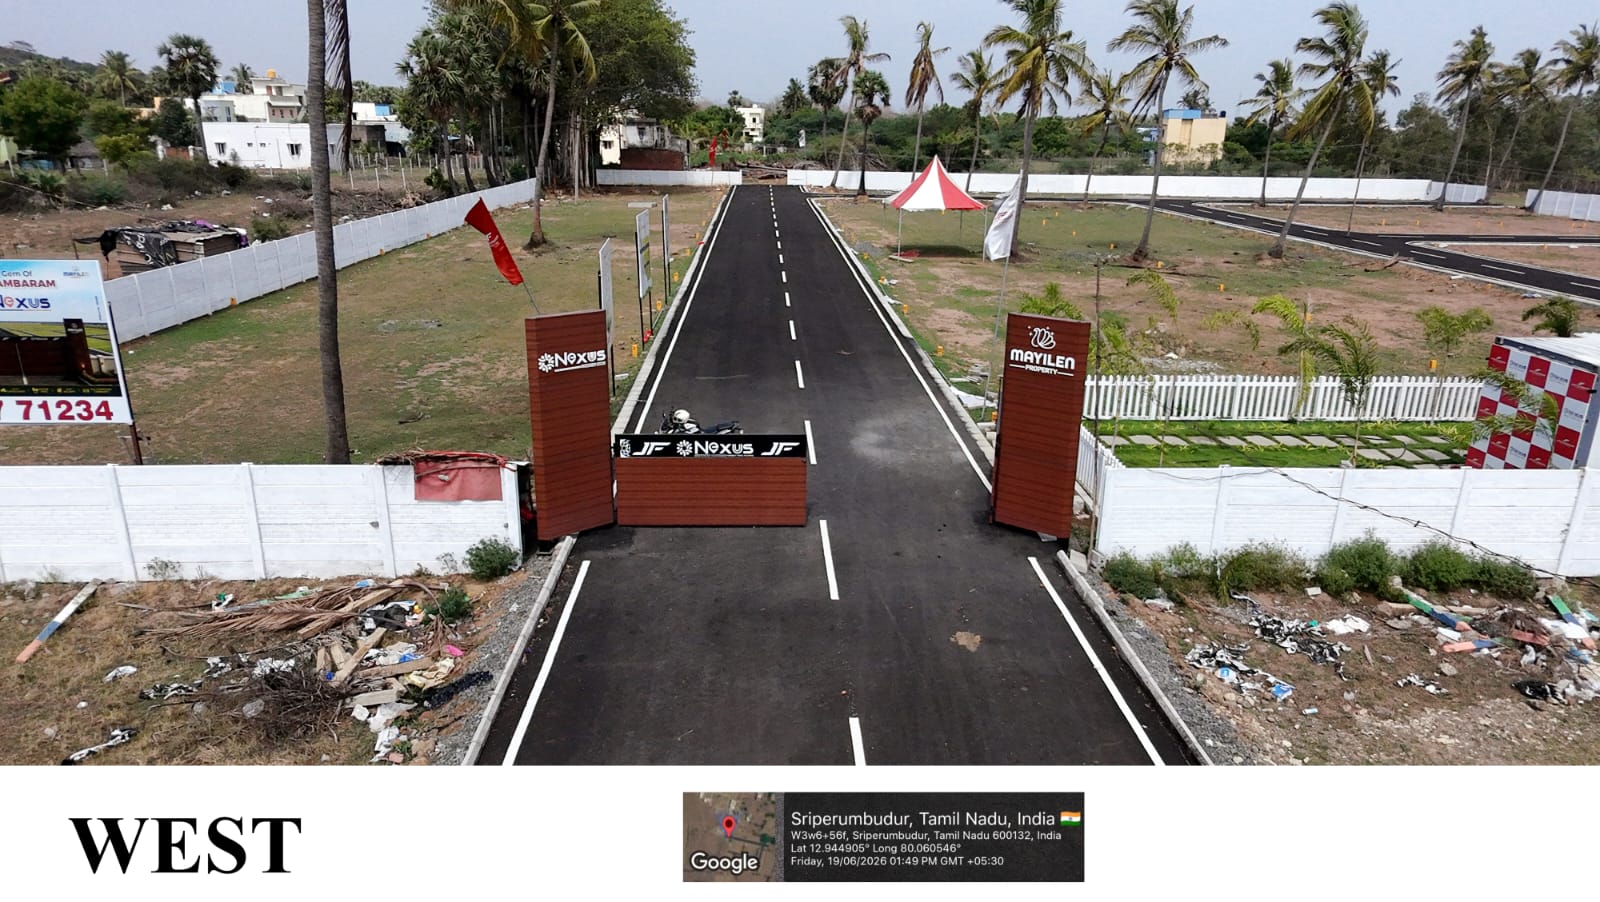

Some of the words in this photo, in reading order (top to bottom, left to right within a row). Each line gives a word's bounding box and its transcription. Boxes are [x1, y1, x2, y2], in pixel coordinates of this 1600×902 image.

[1010, 348, 1076, 370] MAYILEN
[1024, 364, 1058, 375] PROPERTY
[16, 400, 114, 421] 71234
